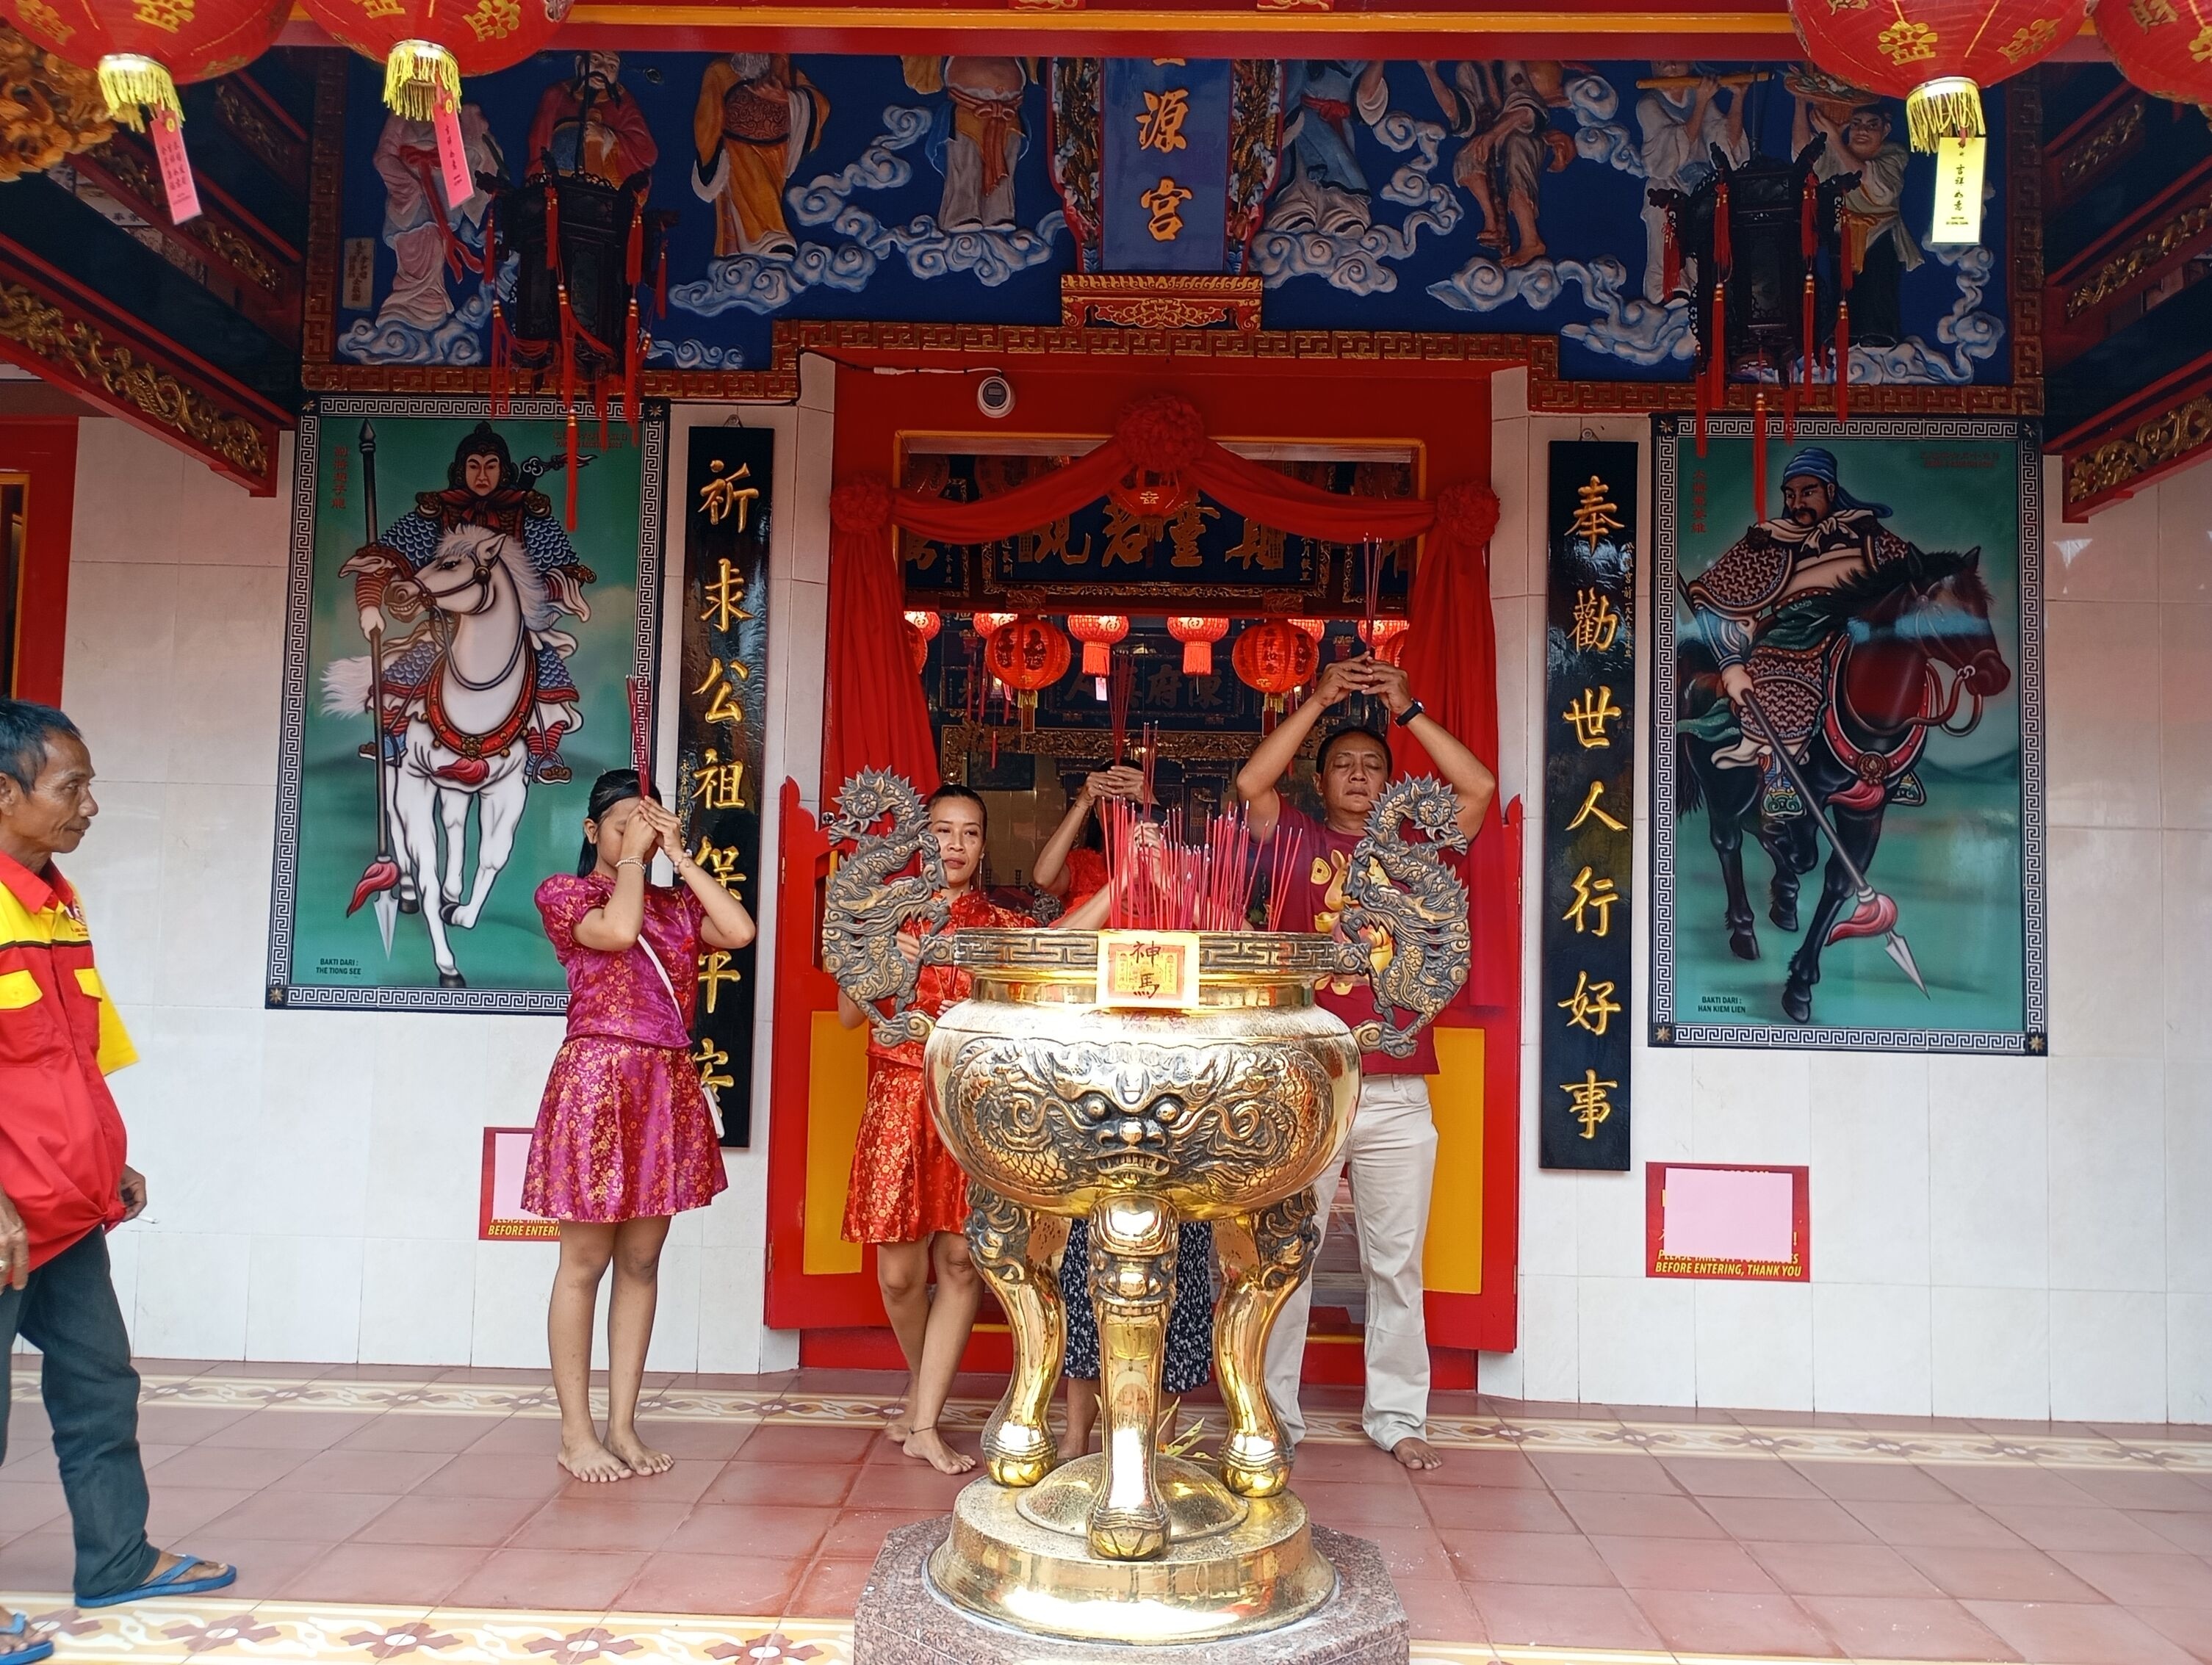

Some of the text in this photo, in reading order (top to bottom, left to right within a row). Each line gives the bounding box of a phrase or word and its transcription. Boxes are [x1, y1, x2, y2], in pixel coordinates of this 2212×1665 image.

[1135, 58, 1193, 242] 源宮
[1557, 474, 1628, 1139] 奉勸世人行好事
[488, 1225, 561, 1237] BEFORE ENTERI
[1655, 1262, 1802, 1276] BEFORE ENTERING, THANK YOU
